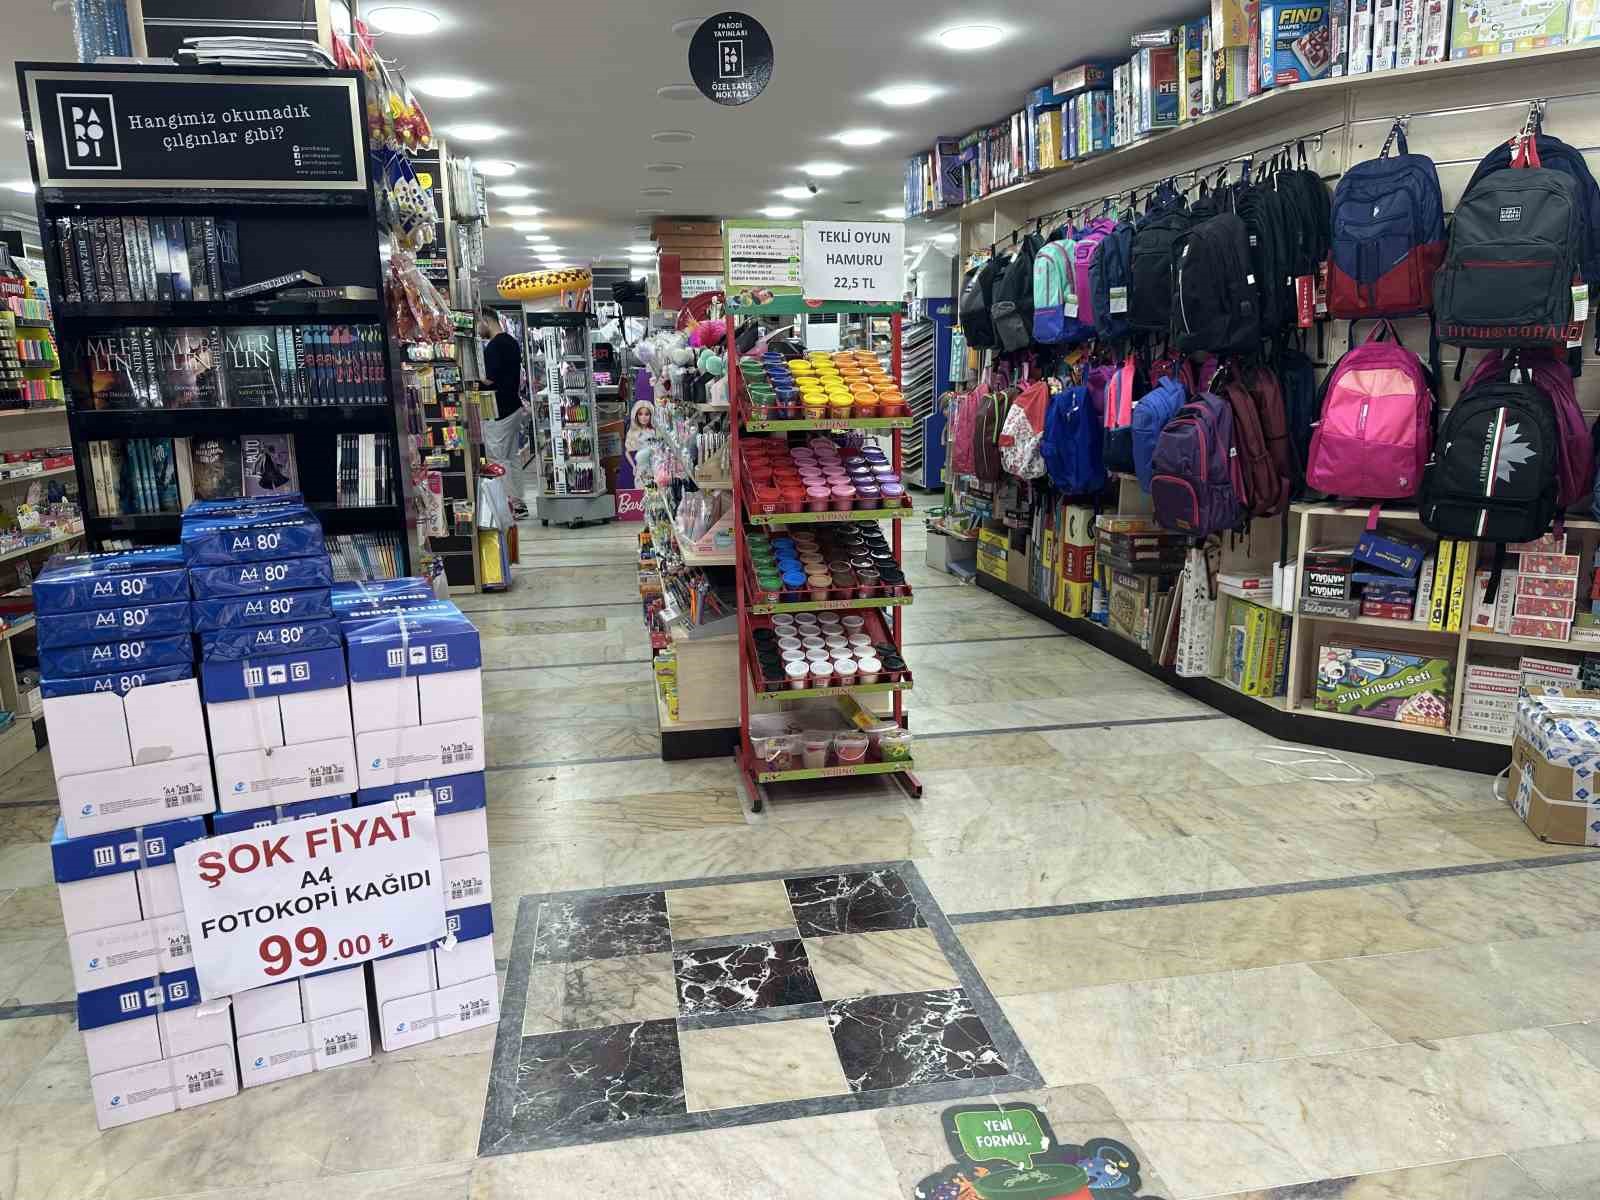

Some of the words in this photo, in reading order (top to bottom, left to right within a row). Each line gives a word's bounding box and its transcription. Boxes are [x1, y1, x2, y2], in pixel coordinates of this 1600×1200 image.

[1279, 8, 1322, 25] FIND
[128, 112, 216, 130] Hangimiz
[222, 104, 311, 124] okumadık
[162, 130, 238, 151] çılgınlar
[819, 229, 851, 244] TEKLİ
[854, 231, 891, 244] OYUN
[826, 254, 883, 266] HAMURU
[834, 277, 859, 290] 22,5
[862, 278, 876, 289] TL
[225, 335, 274, 353] MER
[233, 350, 272, 368] LIN
[295, 336, 306, 369] MERLIN
[232, 537, 250, 549] A4
[240, 568, 259, 581] A4
[1309, 573, 1345, 583] MANGALA
[93, 581, 113, 594] A4
[1309, 586, 1344, 597] MANGALA
[245, 600, 263, 614] A4
[96, 612, 115, 626] A4
[256, 630, 273, 643] A4
[92, 645, 112, 659] A4
[295, 665, 305, 677] 6
[94, 679, 113, 691] A4
[440, 789, 449, 800] 6
[150, 841, 160, 854] 6
[197, 835, 295, 888] ŞOK
[306, 810, 417, 858] FİYAT
[301, 867, 333, 889] A4
[201, 887, 338, 939] FOTOKOPİ
[346, 870, 431, 904] KAĞIDI
[173, 984, 184, 997] 6
